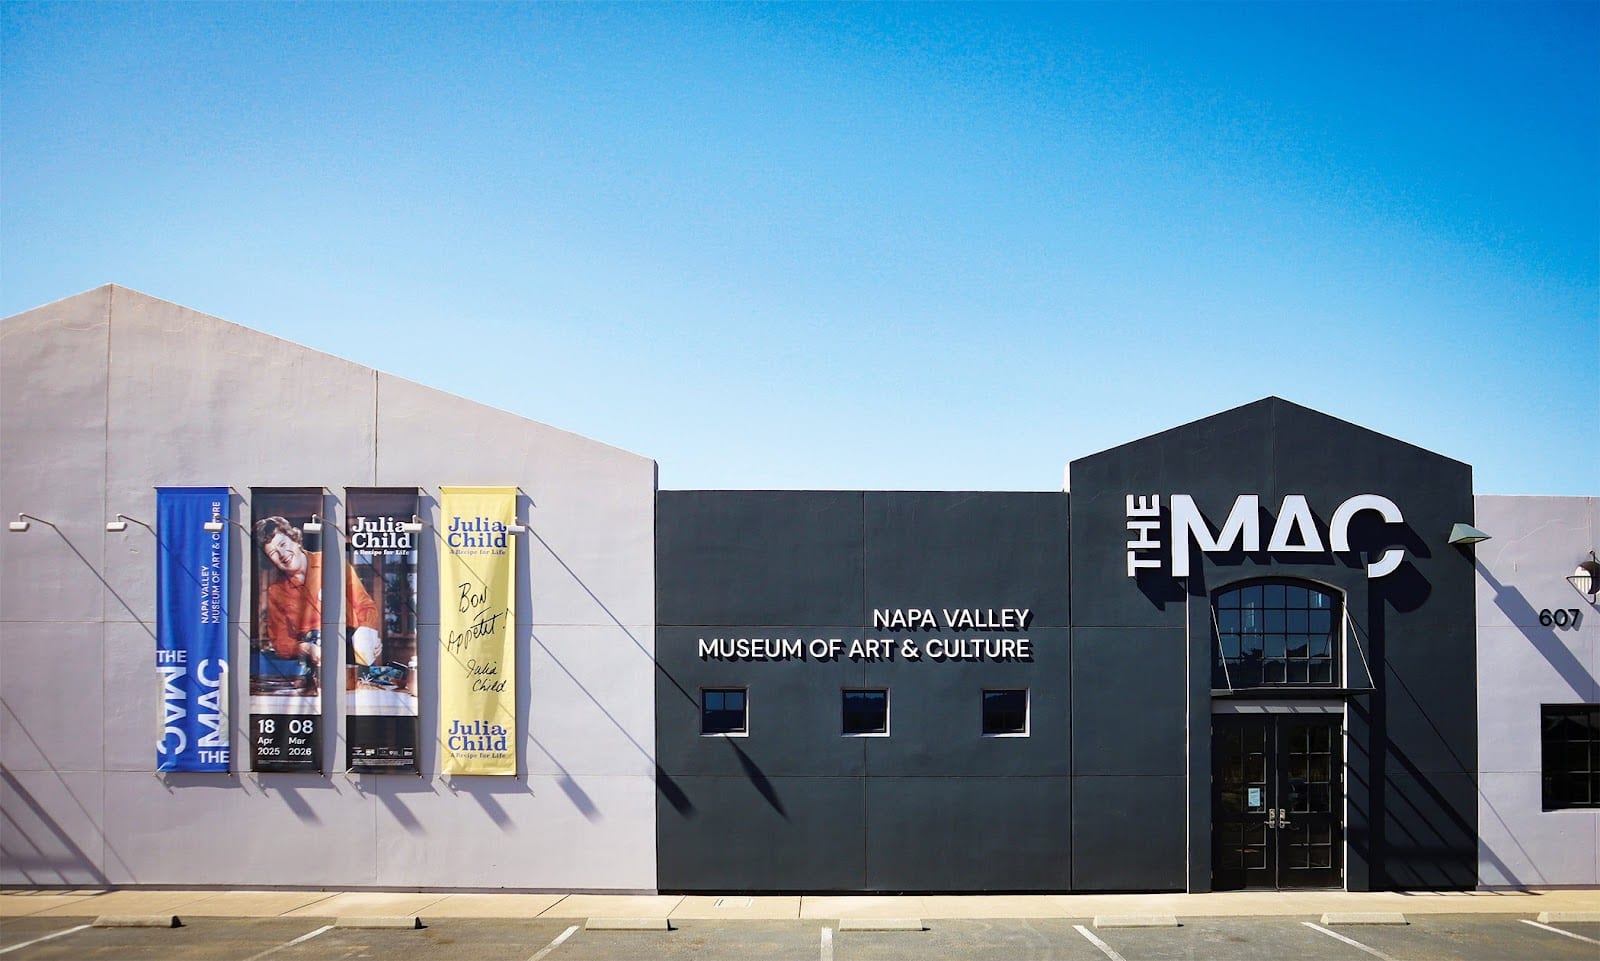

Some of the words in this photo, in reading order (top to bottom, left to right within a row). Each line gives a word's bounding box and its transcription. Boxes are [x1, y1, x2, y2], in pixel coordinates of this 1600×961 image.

[352, 516, 407, 533] Julia
[448, 516, 507, 532] Julia
[351, 532, 412, 549] Child
[448, 532, 508, 548] Child
[1126, 494, 1161, 577] THE
[1170, 494, 1405, 578] MAC
[212, 542, 220, 550] &
[212, 552, 220, 568] ART
[201, 566, 209, 598] VALLEY
[212, 571, 220, 583] OF
[201, 600, 209, 624] NAPA
[212, 586, 220, 624] MUSEUM
[873, 609, 936, 628] NAPA
[944, 609, 1029, 628] VALLEY
[1539, 609, 1580, 627] 607
[156, 650, 187, 663] THE
[698, 639, 802, 658] MUSEUM
[809, 639, 842, 658] OF
[849, 639, 894, 658] ART
[901, 639, 919, 658] &
[926, 639, 1030, 658] CULTURE
[157, 666, 187, 755] MAC
[197, 659, 229, 747] MAC
[257, 719, 275, 734] 18
[288, 719, 313, 734] 08
[448, 720, 507, 736] Julia
[257, 737, 274, 746] Apr
[288, 737, 306, 745] Mar
[448, 735, 508, 751] Child
[198, 751, 230, 763] THE
[257, 747, 280, 756] 2025
[288, 747, 312, 756] 2026
